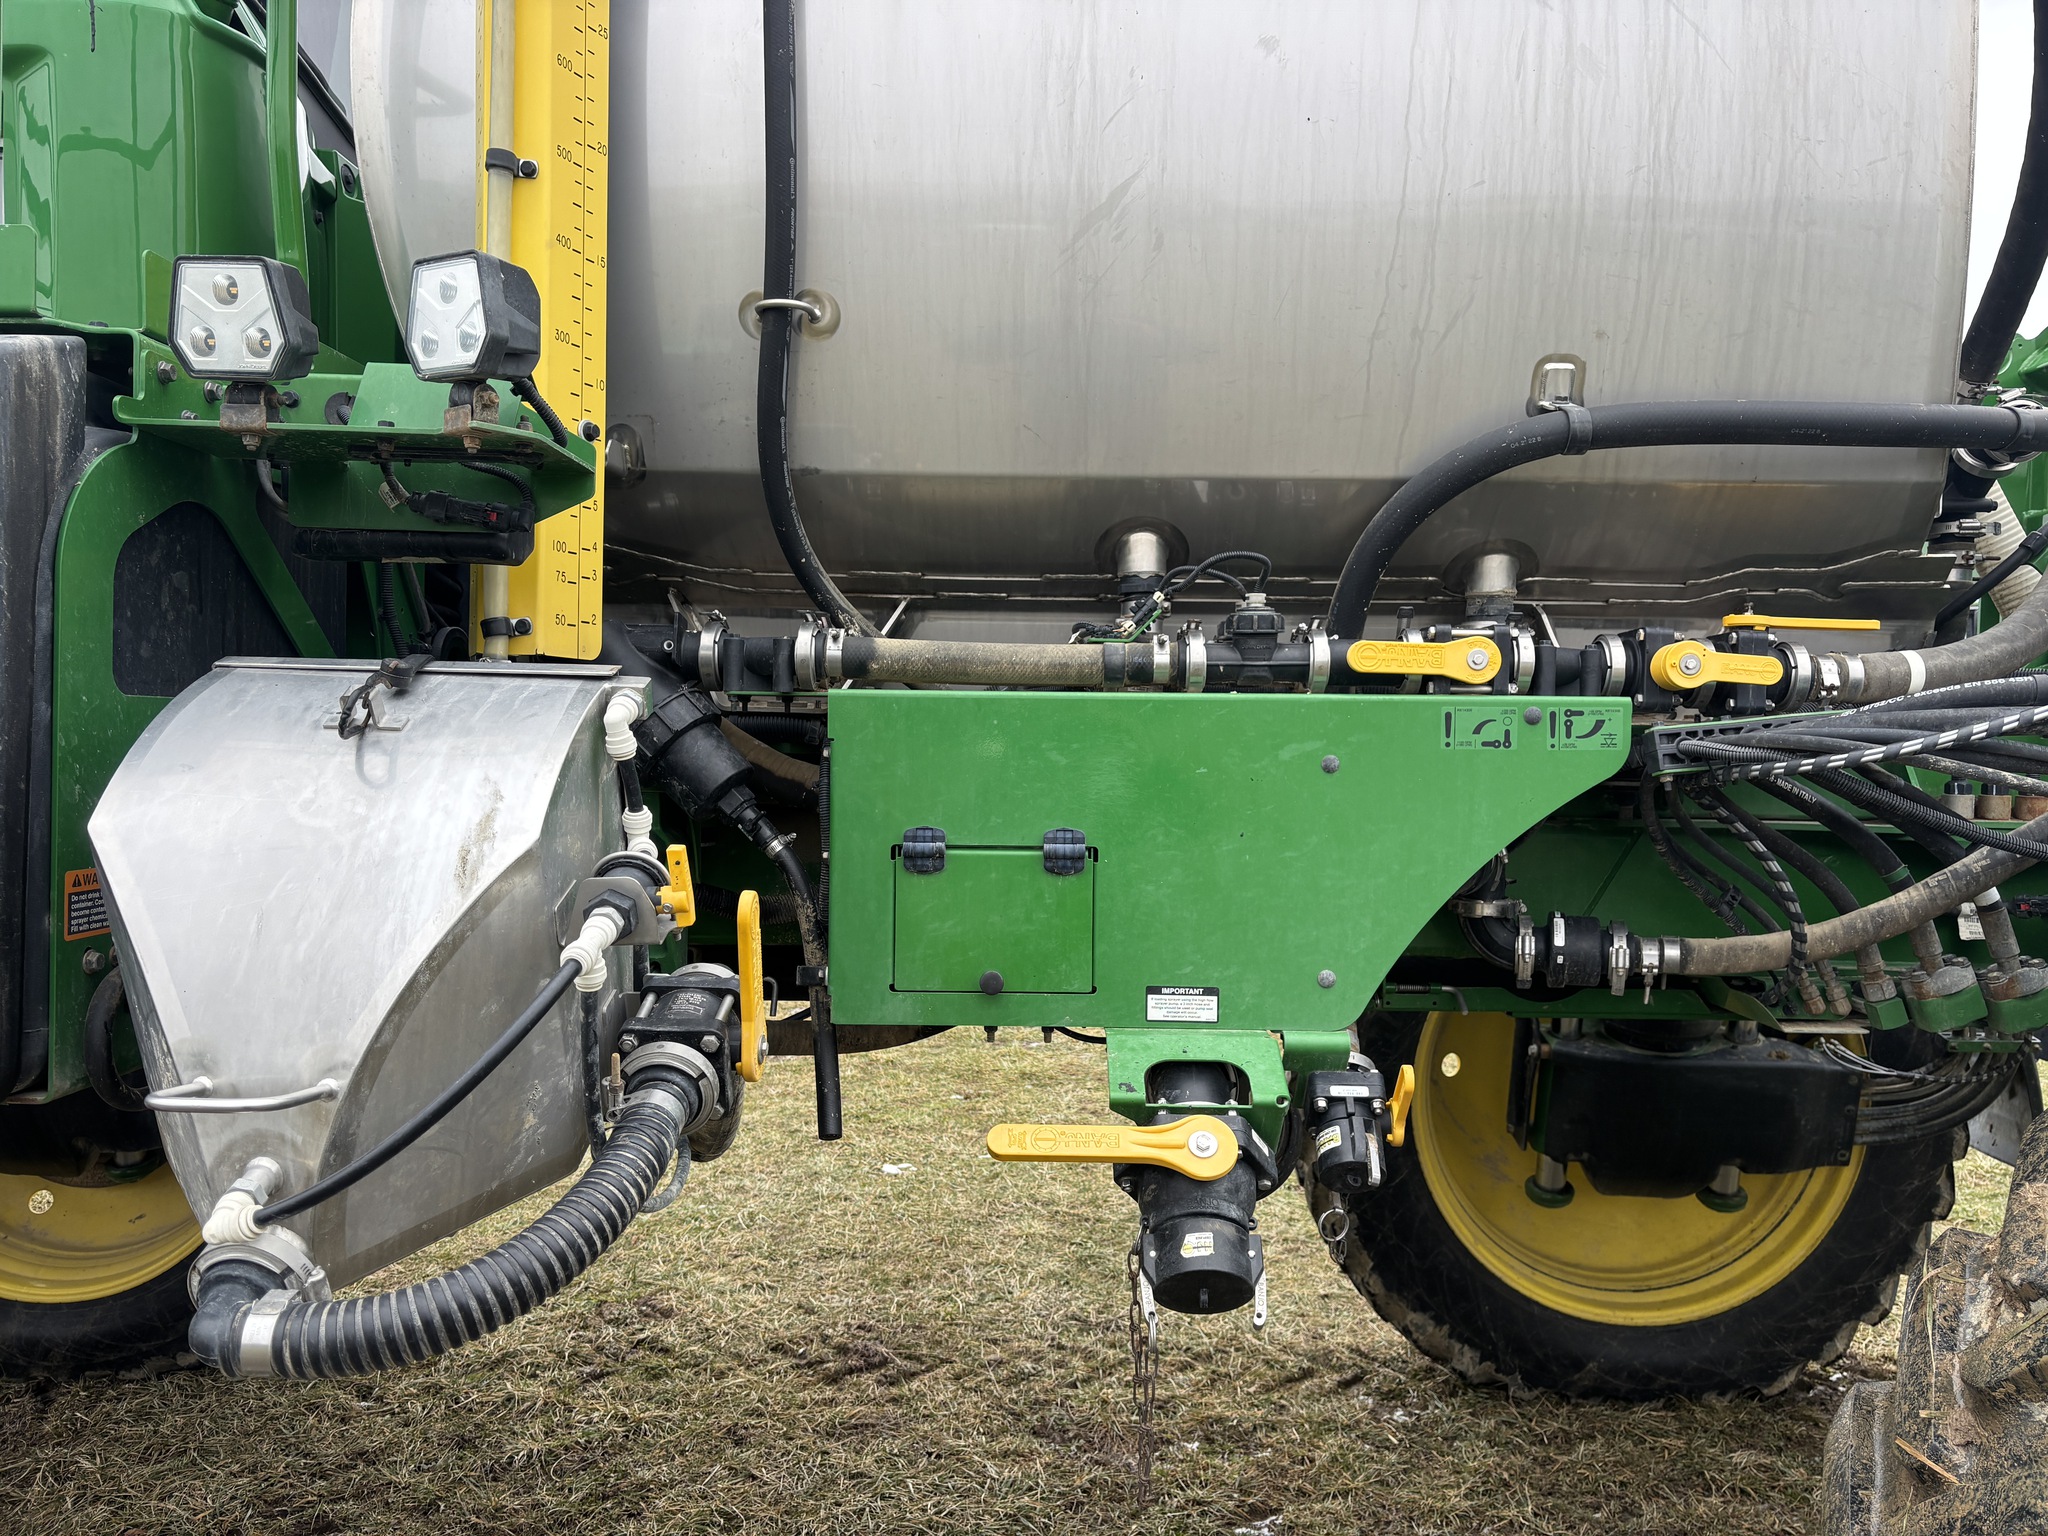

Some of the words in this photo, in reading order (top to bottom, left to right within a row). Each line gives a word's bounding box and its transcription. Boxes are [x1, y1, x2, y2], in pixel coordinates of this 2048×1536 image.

[597, 24, 609, 40] 25
[556, 54, 573, 73] 600
[556, 147, 573, 163] 500
[597, 142, 608, 157] 20
[555, 233, 572, 250] 400
[596, 255, 606, 269] 15
[554, 328, 571, 344] 300
[595, 378, 605, 392] 10
[782, 460, 790, 488] FRONTIER
[592, 500, 599, 512] 5
[552, 539, 567, 554] 100
[592, 541, 598, 553] 4
[556, 570, 567, 584] 75
[591, 569, 598, 582] 3
[555, 613, 566, 627] 50
[591, 615, 597, 626] 2
[1913, 684, 1961, 698] exceeds
[1964, 680, 1981, 689] EN
[1775, 777, 1793, 792] MADE
[1791, 785, 1800, 796] IN
[1798, 788, 1817, 804] ITALY
[71, 900, 95, 910] container.
[71, 909, 90, 917] become
[71, 917, 89, 926] sprayer
[71, 925, 79, 933] Fill
[79, 923, 90, 931] with
[89, 921, 103, 929] clean
[1161, 987, 1204, 995] IMPORTANT
